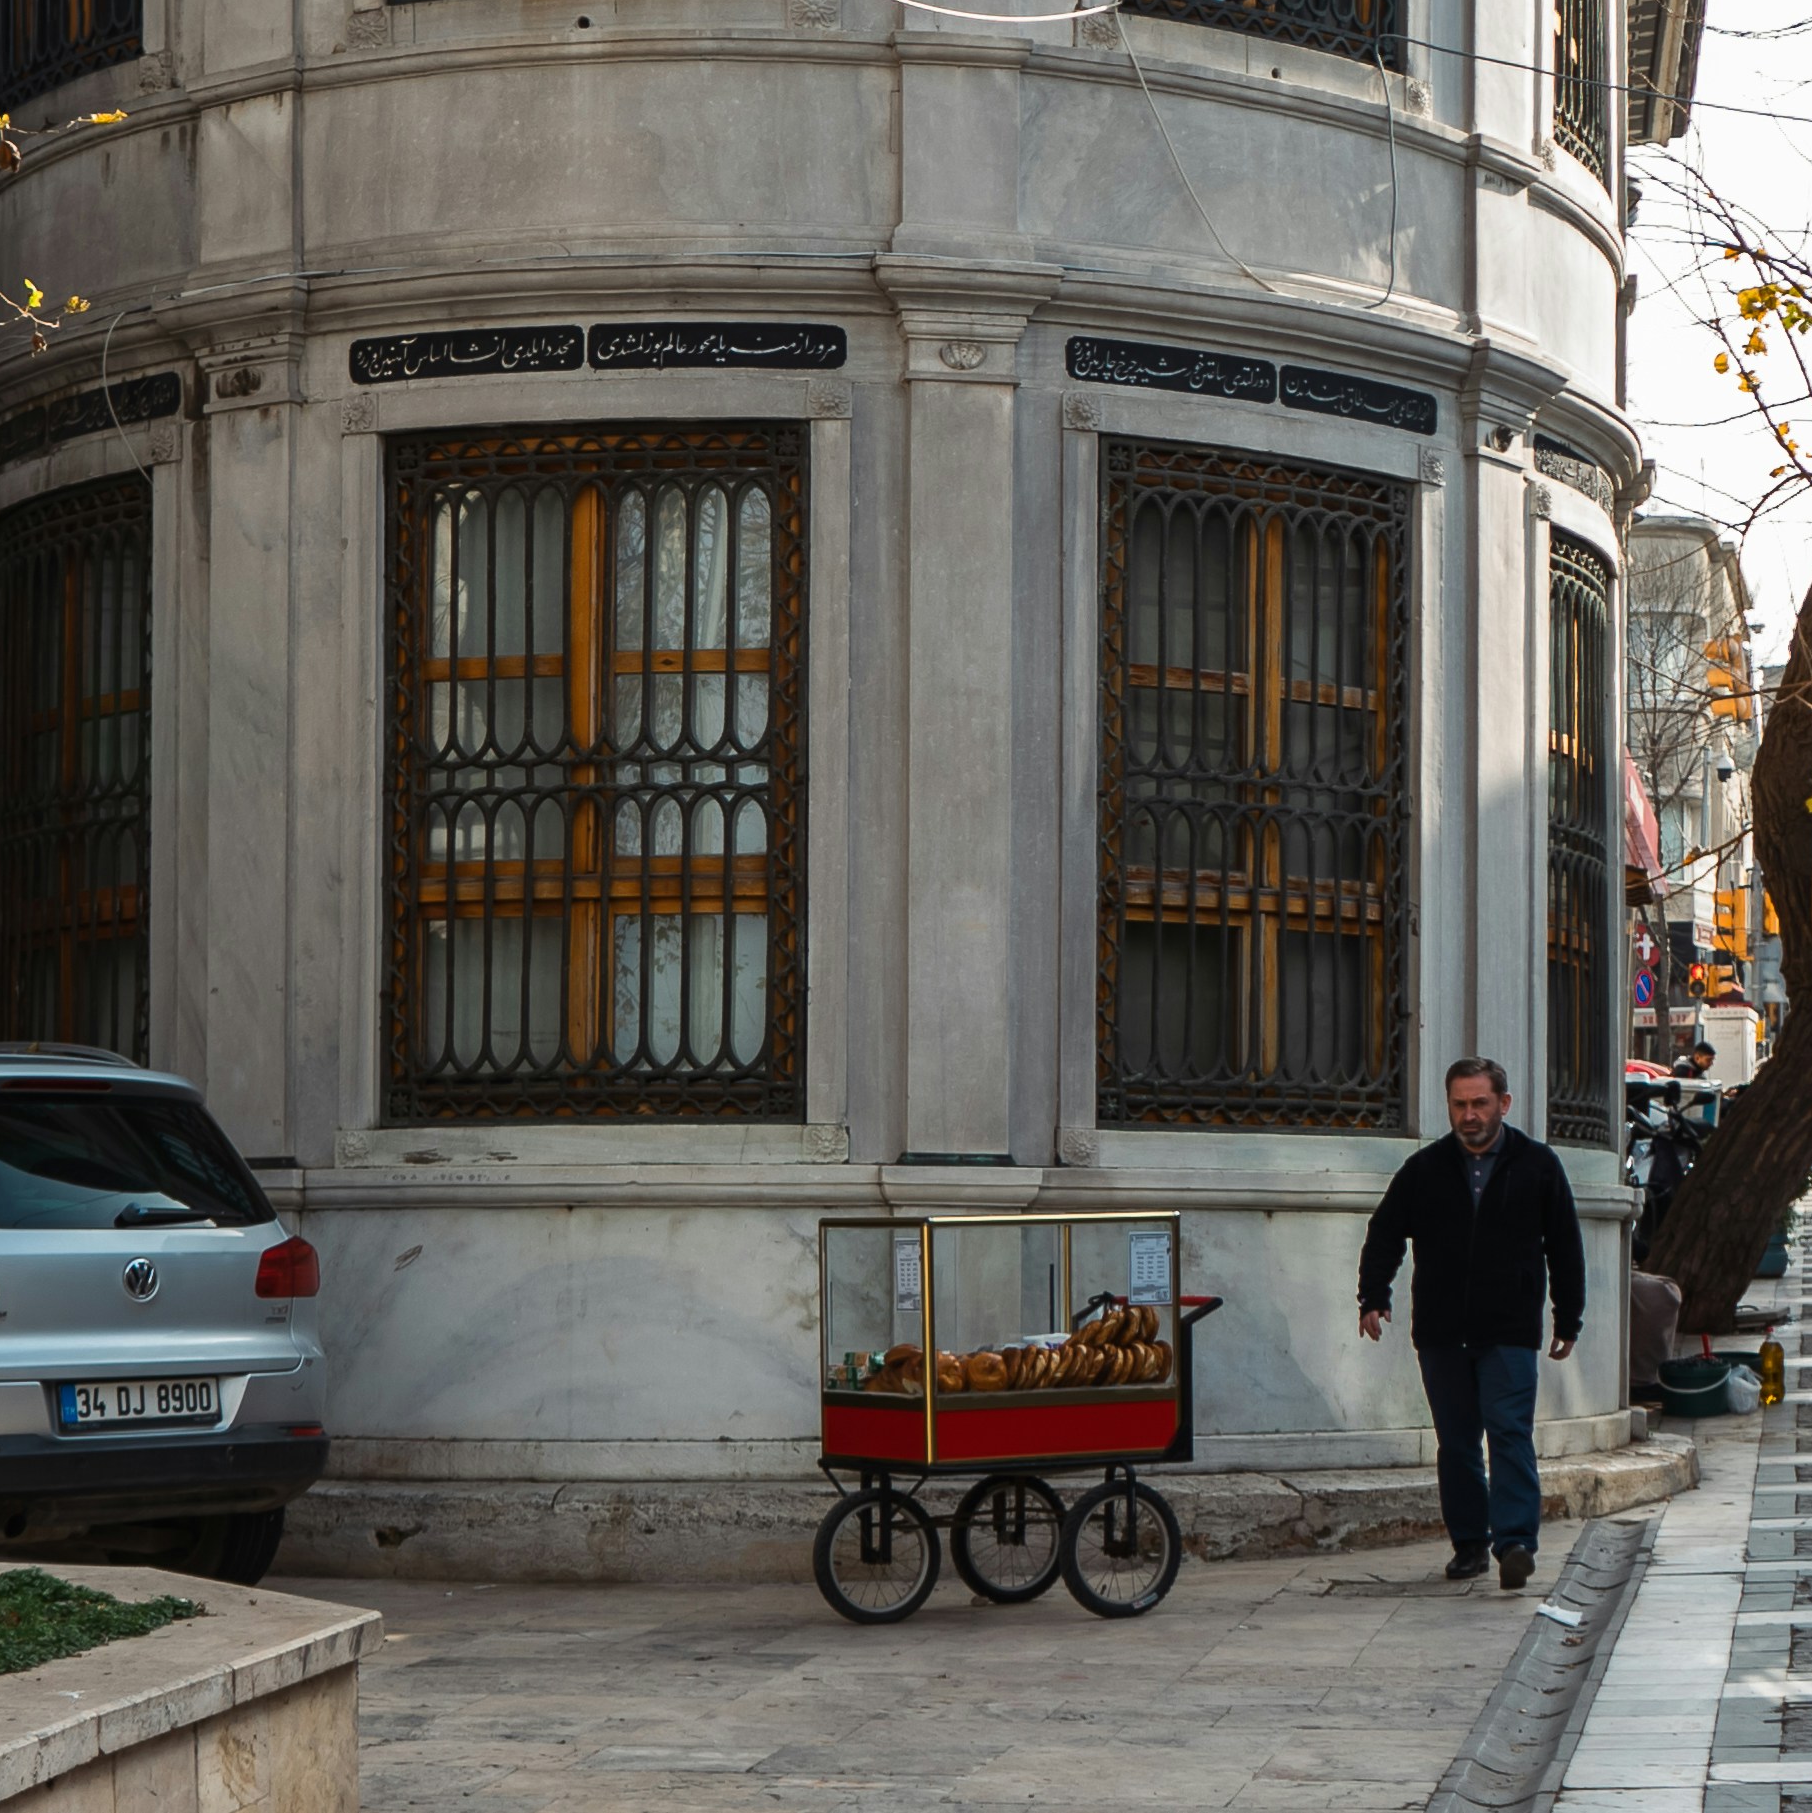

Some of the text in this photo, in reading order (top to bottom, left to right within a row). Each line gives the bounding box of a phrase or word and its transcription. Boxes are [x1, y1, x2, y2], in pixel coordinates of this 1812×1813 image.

[77, 1387, 106, 1418] 34
[117, 1385, 145, 1416] DJ
[157, 1382, 211, 1413] 8900
